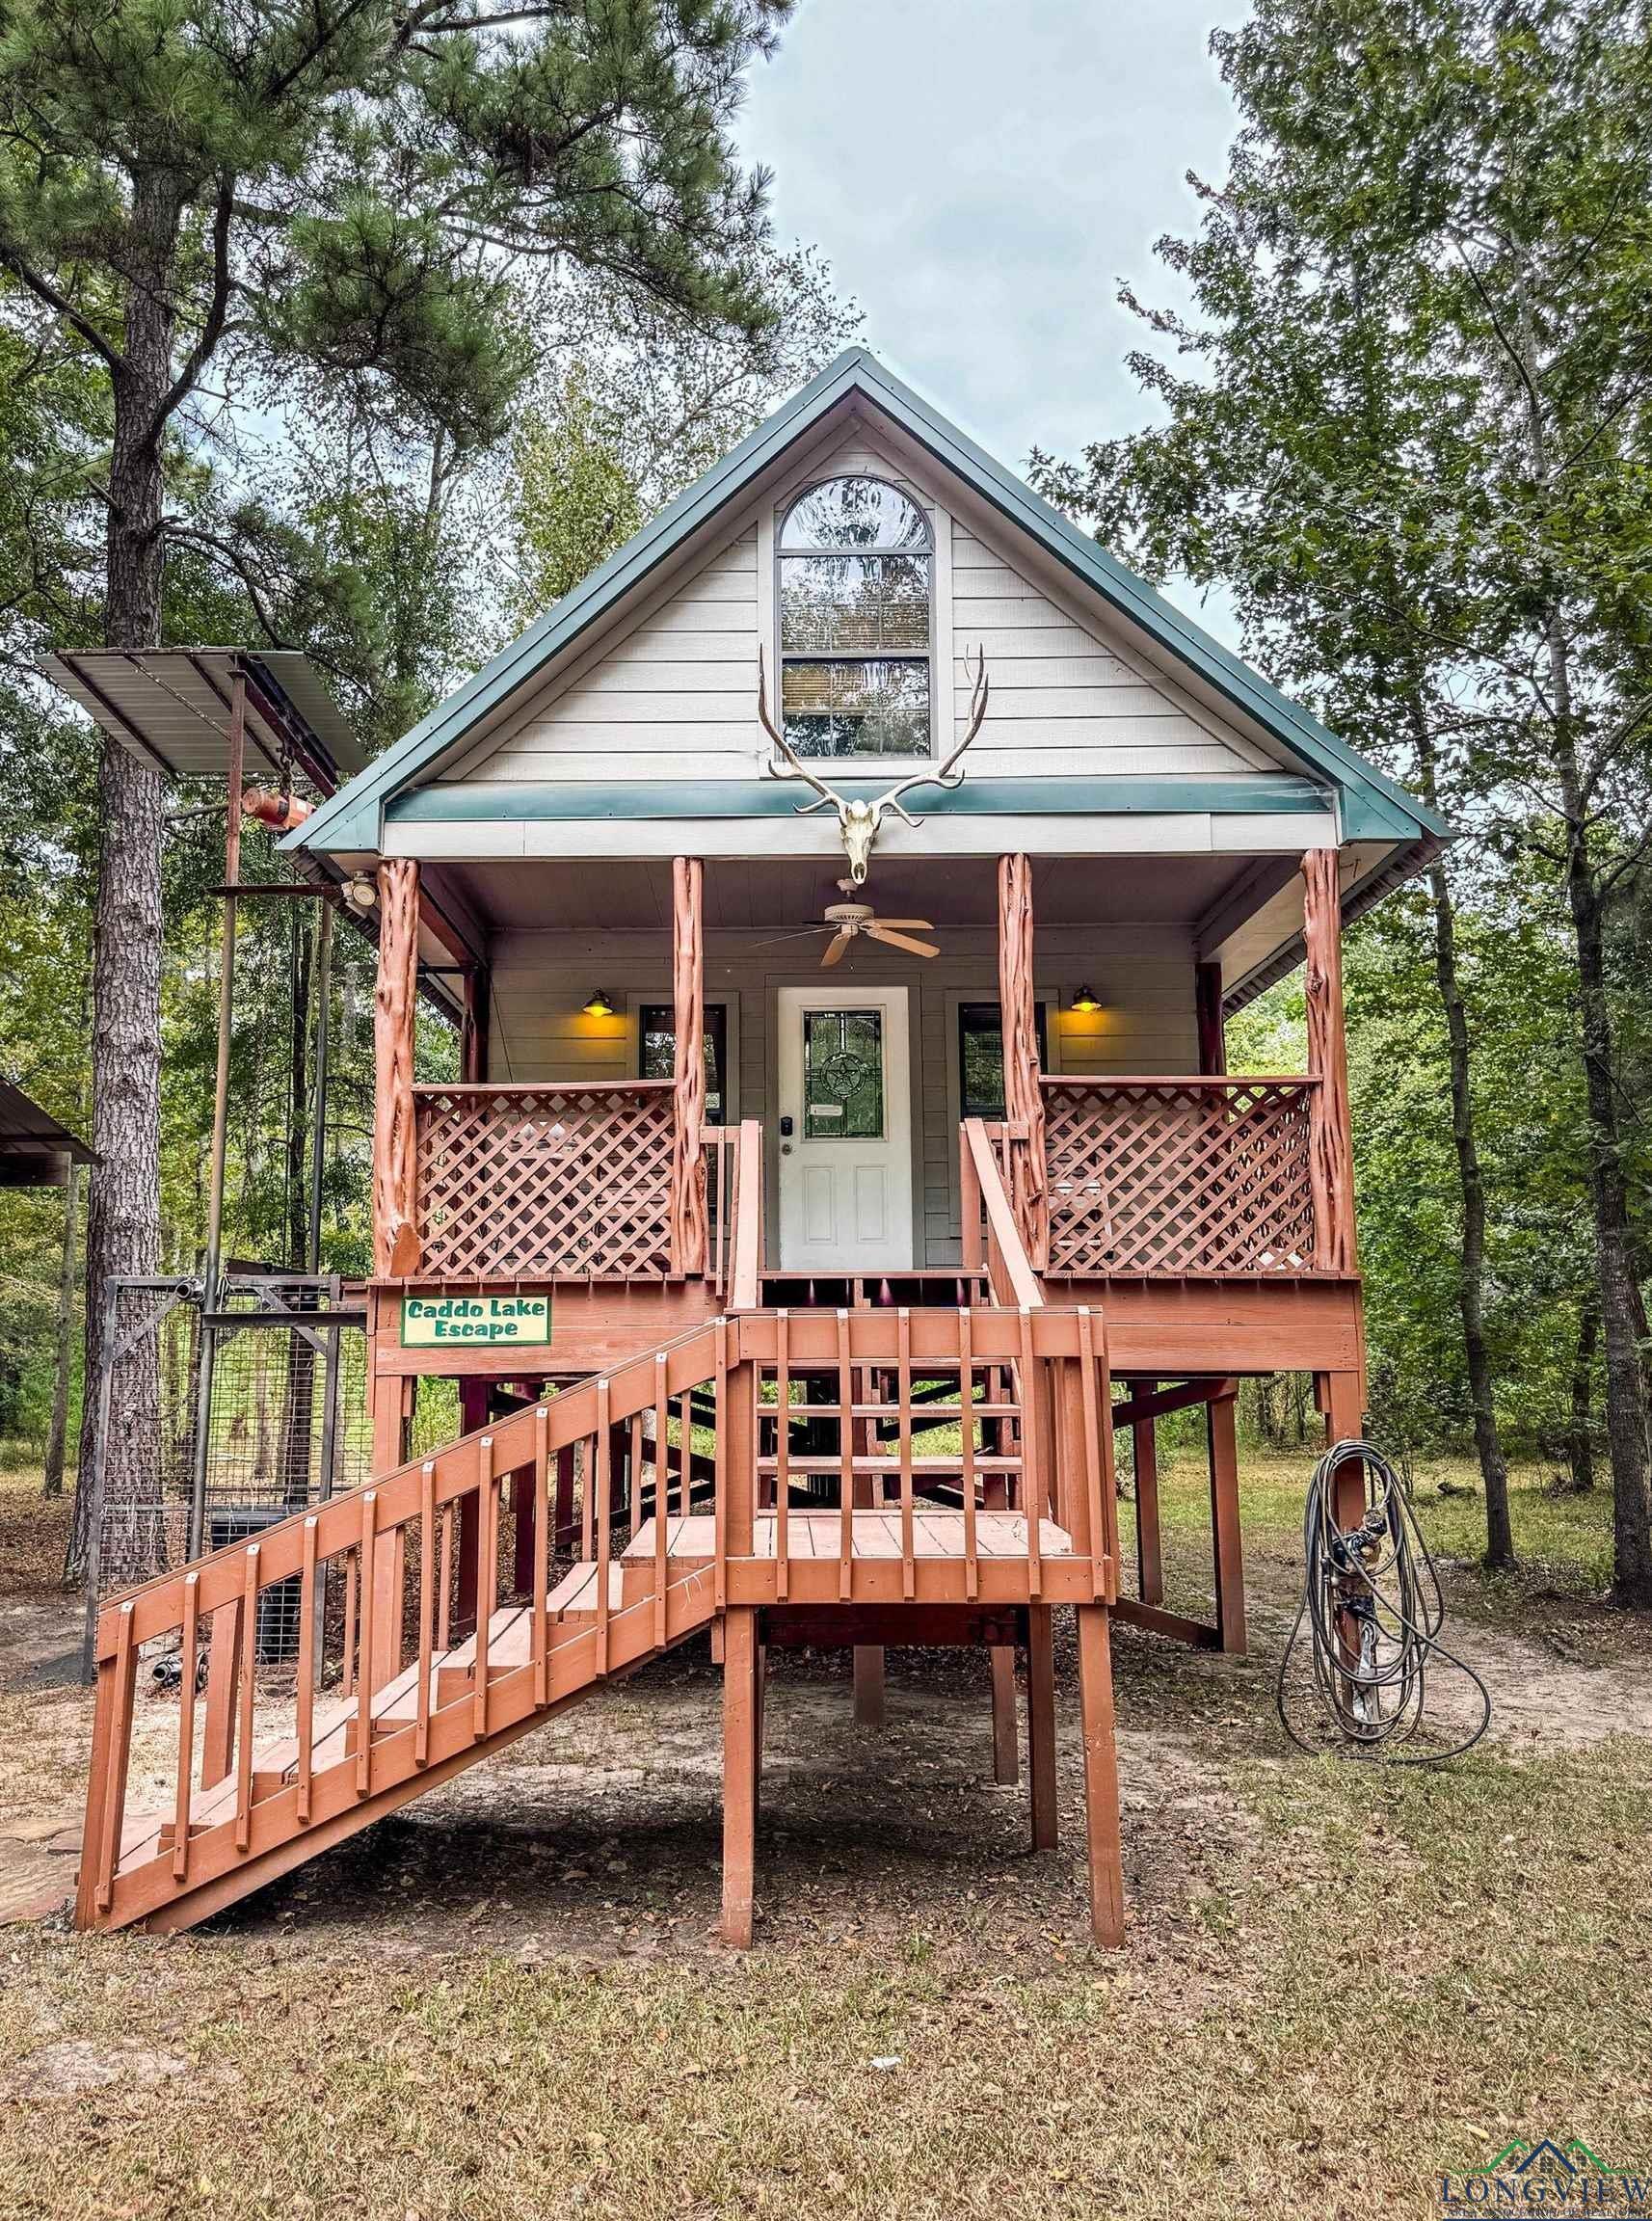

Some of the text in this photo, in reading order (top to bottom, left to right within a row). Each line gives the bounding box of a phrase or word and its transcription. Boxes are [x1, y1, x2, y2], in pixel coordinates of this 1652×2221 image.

[408, 1298, 546, 1318] Caddo Lake
[435, 1320, 519, 1339] Escape
